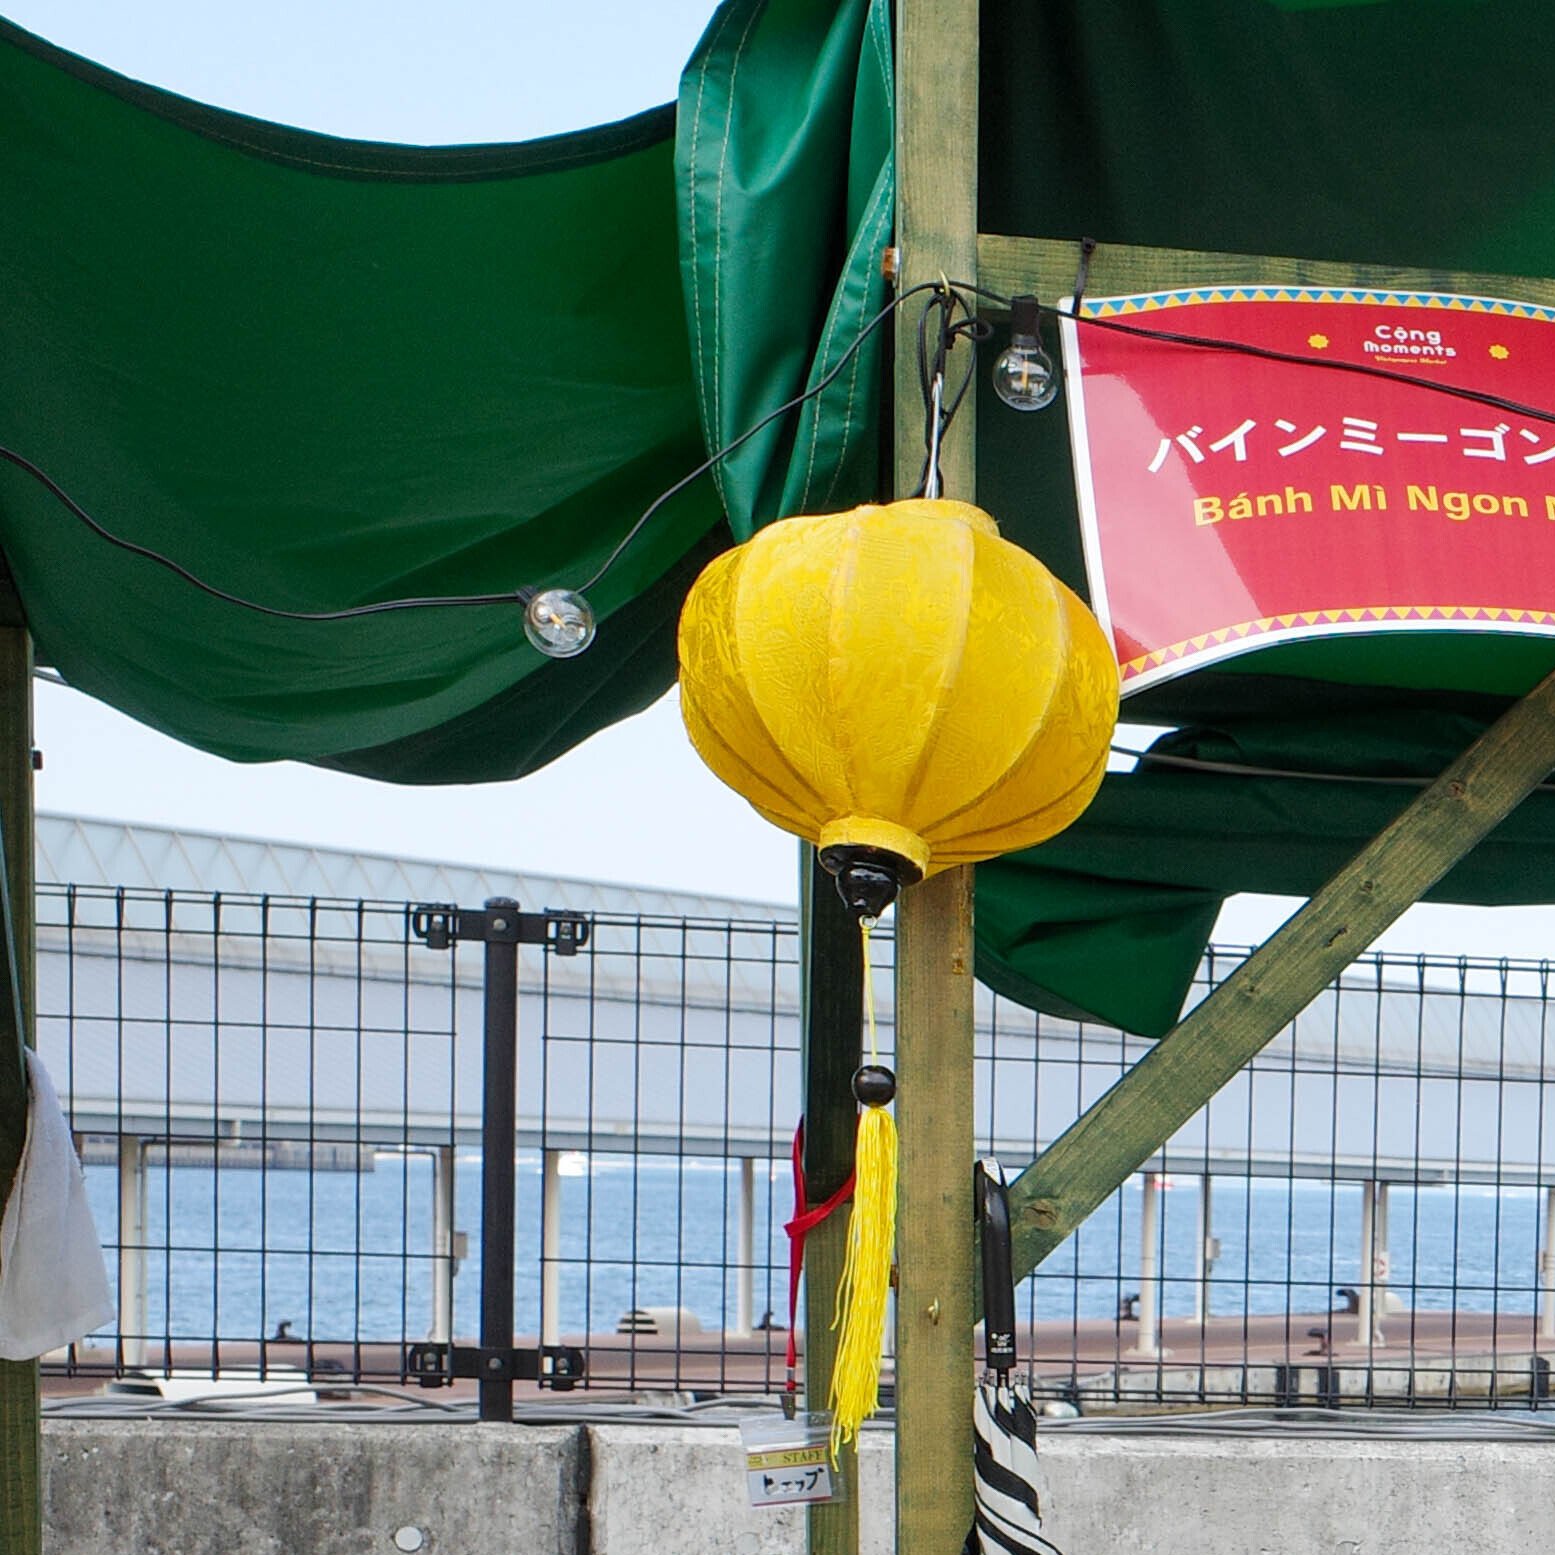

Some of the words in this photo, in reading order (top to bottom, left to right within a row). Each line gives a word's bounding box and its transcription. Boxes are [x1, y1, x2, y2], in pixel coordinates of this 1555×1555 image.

[1193, 485, 1314, 527] Bánh
[1330, 484, 1389, 512] Mì
[1406, 485, 1528, 520] Ngon
